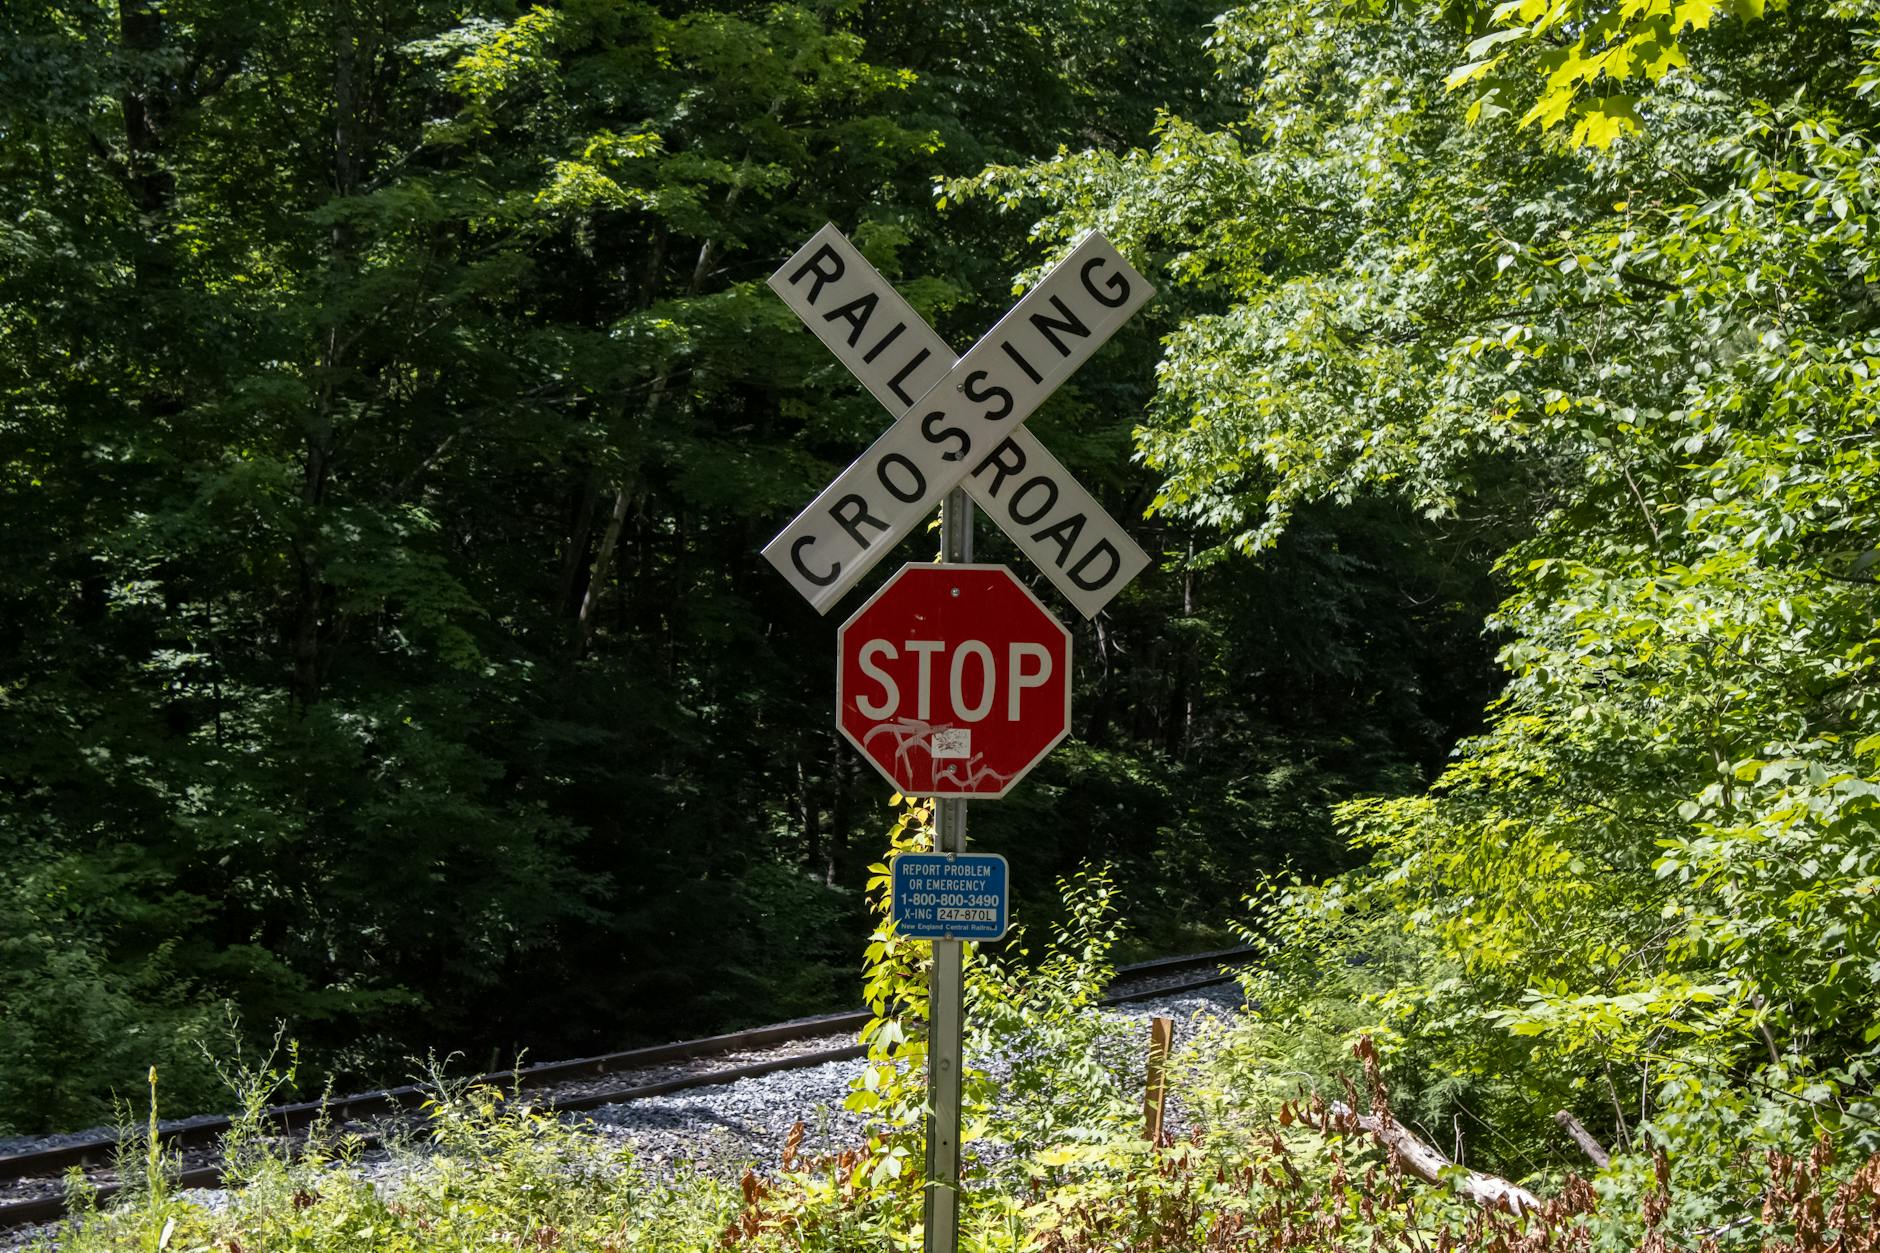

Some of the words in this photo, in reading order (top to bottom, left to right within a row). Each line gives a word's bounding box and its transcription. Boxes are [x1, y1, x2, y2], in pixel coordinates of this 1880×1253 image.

[788, 243, 931, 407] RAIL
[971, 436, 1121, 592] ROAD
[790, 257, 1131, 587] CROSSING
[855, 638, 1053, 722] STOP
[903, 864, 941, 876] REPORT
[944, 865, 990, 876] PROBLEM
[909, 879, 922, 890] OR
[927, 879, 986, 891] EMERGENCY
[901, 893, 999, 907] 1-800-800-3490
[905, 908, 932, 920] X-ING
[939, 910, 992, 920] 247-870L
